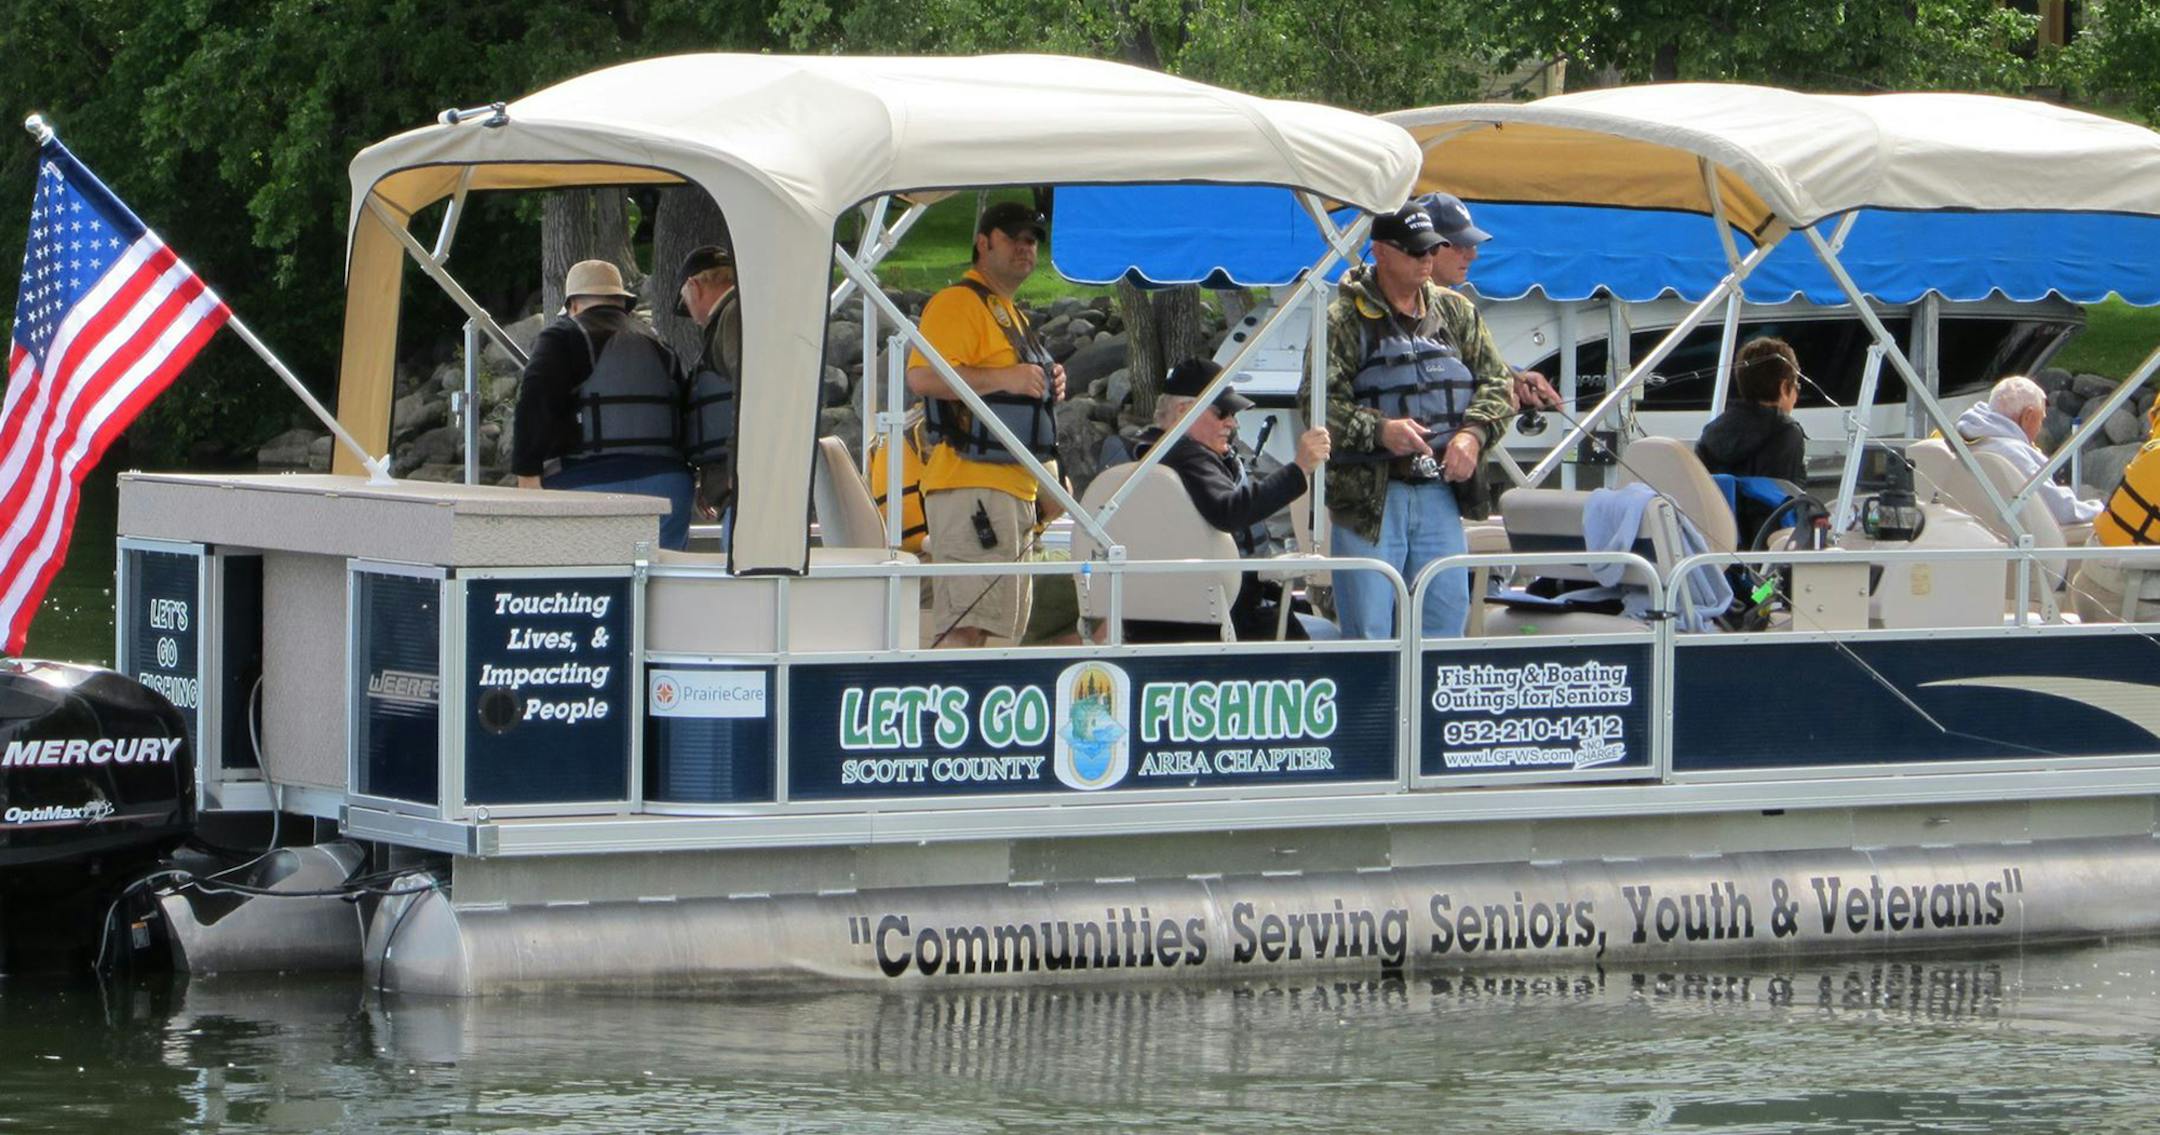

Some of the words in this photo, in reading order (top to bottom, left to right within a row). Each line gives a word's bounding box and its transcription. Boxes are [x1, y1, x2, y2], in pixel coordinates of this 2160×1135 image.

[150, 599, 188, 631] LET'S
[495, 592, 611, 618] Touching
[157, 637, 177, 668] GO
[506, 628, 577, 652] Lives,
[591, 626, 609, 648] &
[479, 663, 610, 689] Impacting
[1438, 664, 1521, 689] Fishing
[1545, 660, 1627, 685] Boating
[684, 686, 764, 701] PrairieCare
[1432, 689, 1517, 714] Outings
[1519, 689, 1552, 708] for
[1553, 686, 1631, 706] Seniors
[523, 697, 609, 724] People
[840, 684, 969, 749] LET'S
[979, 685, 1050, 748] GO
[1141, 678, 1337, 742] FISHING
[1444, 716, 1623, 745] 952-210-1412
[2, 737, 182, 766] MERCURY
[1138, 751, 1212, 776] AREA
[1214, 747, 1334, 773] CHAPTER
[1444, 747, 1573, 767] www.LGFWS.com
[842, 758, 928, 784] SCOTT
[932, 756, 1045, 782] COUNTY
[5, 806, 81, 824] OptiMax
[849, 907, 1207, 977] "Communities
[1232, 899, 1409, 967] Serving
[1430, 891, 1607, 959] Seniors,
[1623, 881, 1754, 944] Youth
[1771, 878, 1799, 938] &
[1811, 868, 2024, 934] Veterans"
